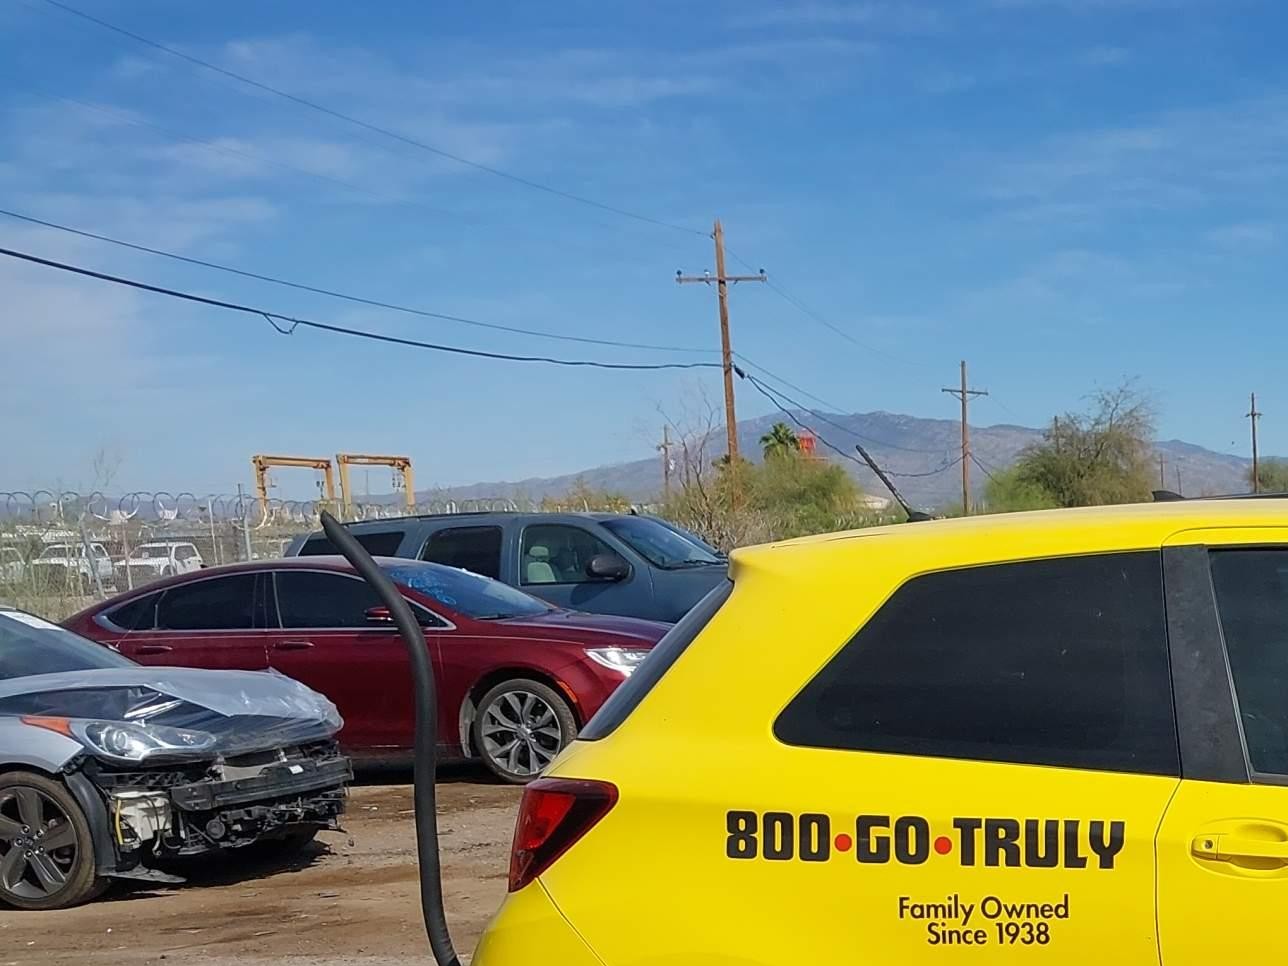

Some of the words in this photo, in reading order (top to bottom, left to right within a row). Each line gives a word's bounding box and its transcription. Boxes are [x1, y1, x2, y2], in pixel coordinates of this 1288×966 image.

[899, 894, 974, 923] Family
[981, 894, 1068, 919] Owned
[928, 922, 987, 944] Since
[996, 922, 1050, 944] 1938
